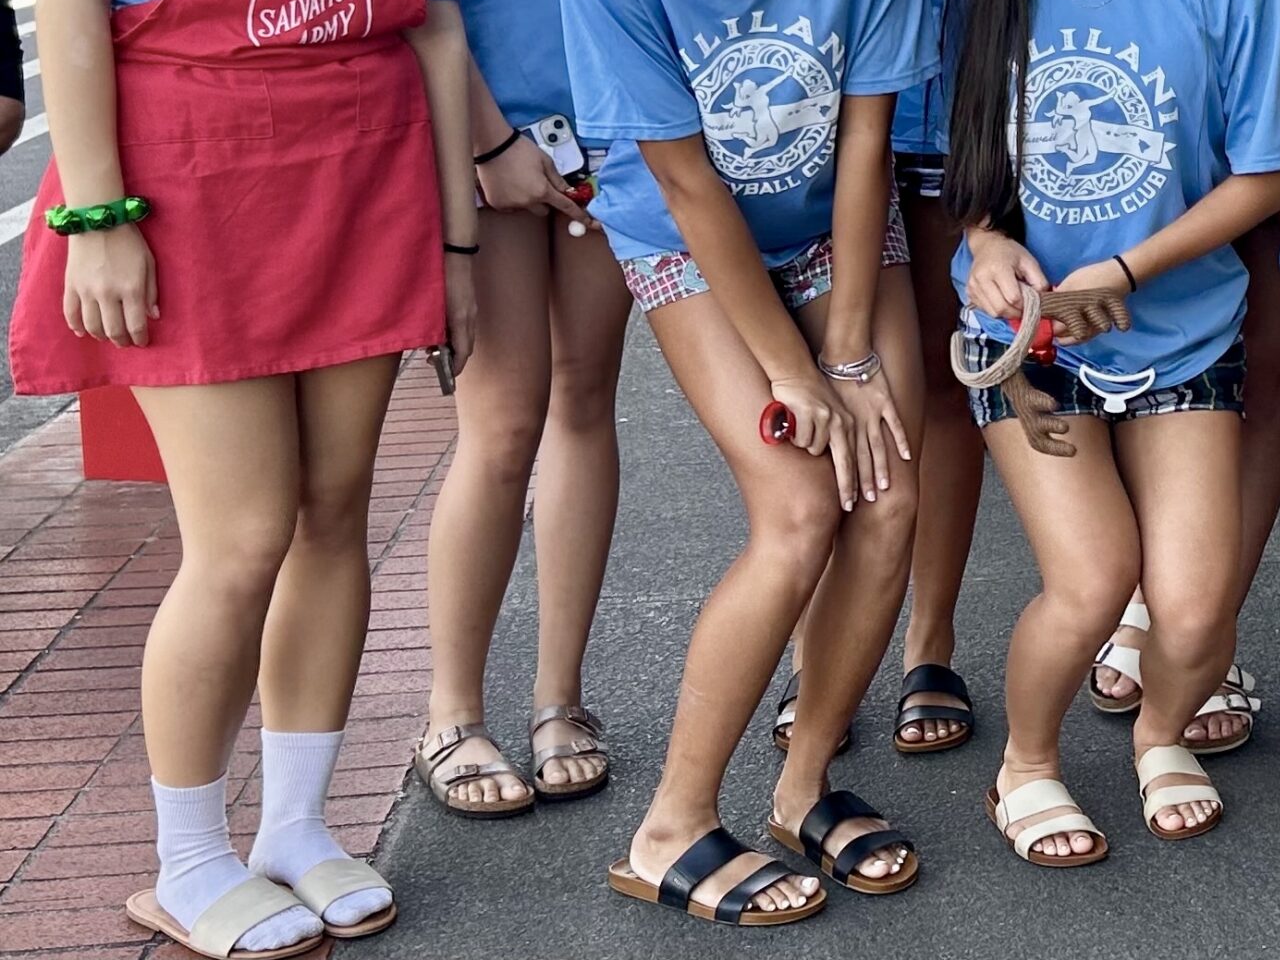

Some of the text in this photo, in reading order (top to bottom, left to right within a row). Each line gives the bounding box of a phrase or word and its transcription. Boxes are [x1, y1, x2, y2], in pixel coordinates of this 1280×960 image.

[679, 10, 845, 81] ILILAN
[1028, 28, 1179, 127] LILANI
[723, 175, 802, 197] YBALL
[1019, 171, 1168, 225] LLEYBALL CLUB
